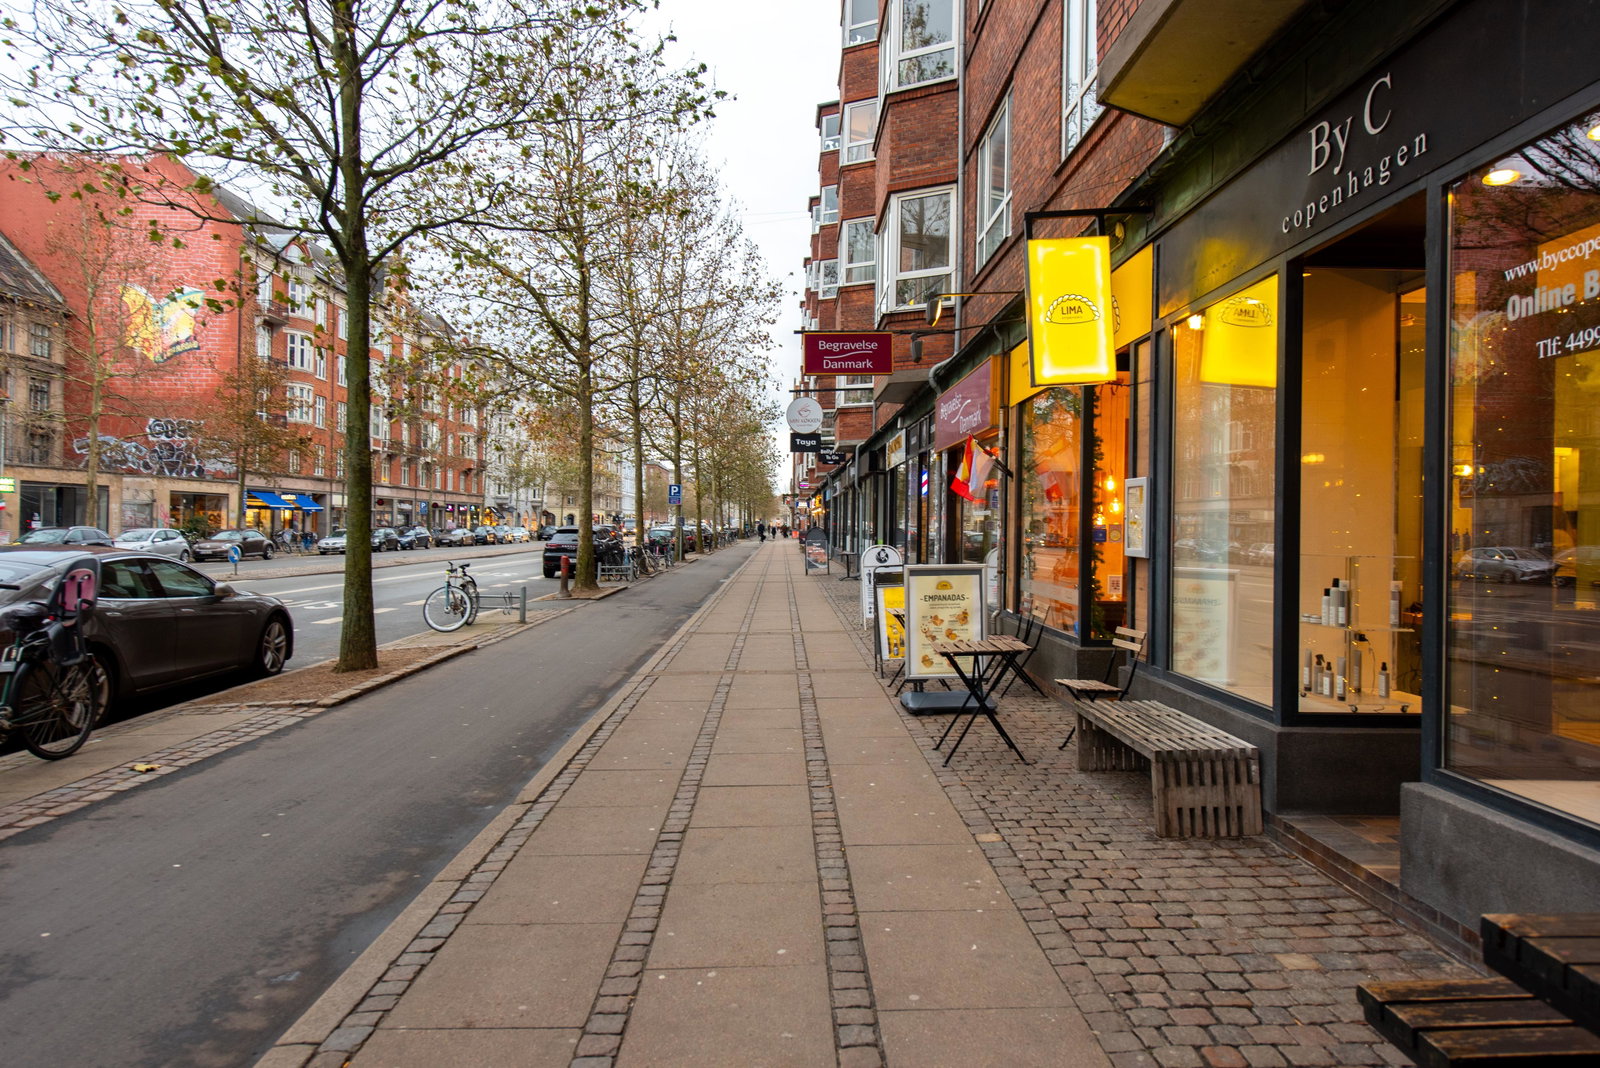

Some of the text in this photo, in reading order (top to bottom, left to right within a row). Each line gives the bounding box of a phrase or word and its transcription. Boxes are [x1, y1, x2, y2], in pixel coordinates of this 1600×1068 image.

[1307, 73, 1392, 177] By C
[1282, 133, 1427, 233] copenhagen
[1506, 283, 1577, 322] Online
[1061, 305, 1083, 315] LIMA
[818, 340, 878, 352] Begravelse
[1535, 335, 1562, 359] Tlf:
[823, 359, 873, 369] Danmark
[959, 404, 983, 434] Danmark
[795, 438, 817, 448] Taya
[670, 485, 679, 496] P
[923, 593, 966, 602] EMPANADAS
